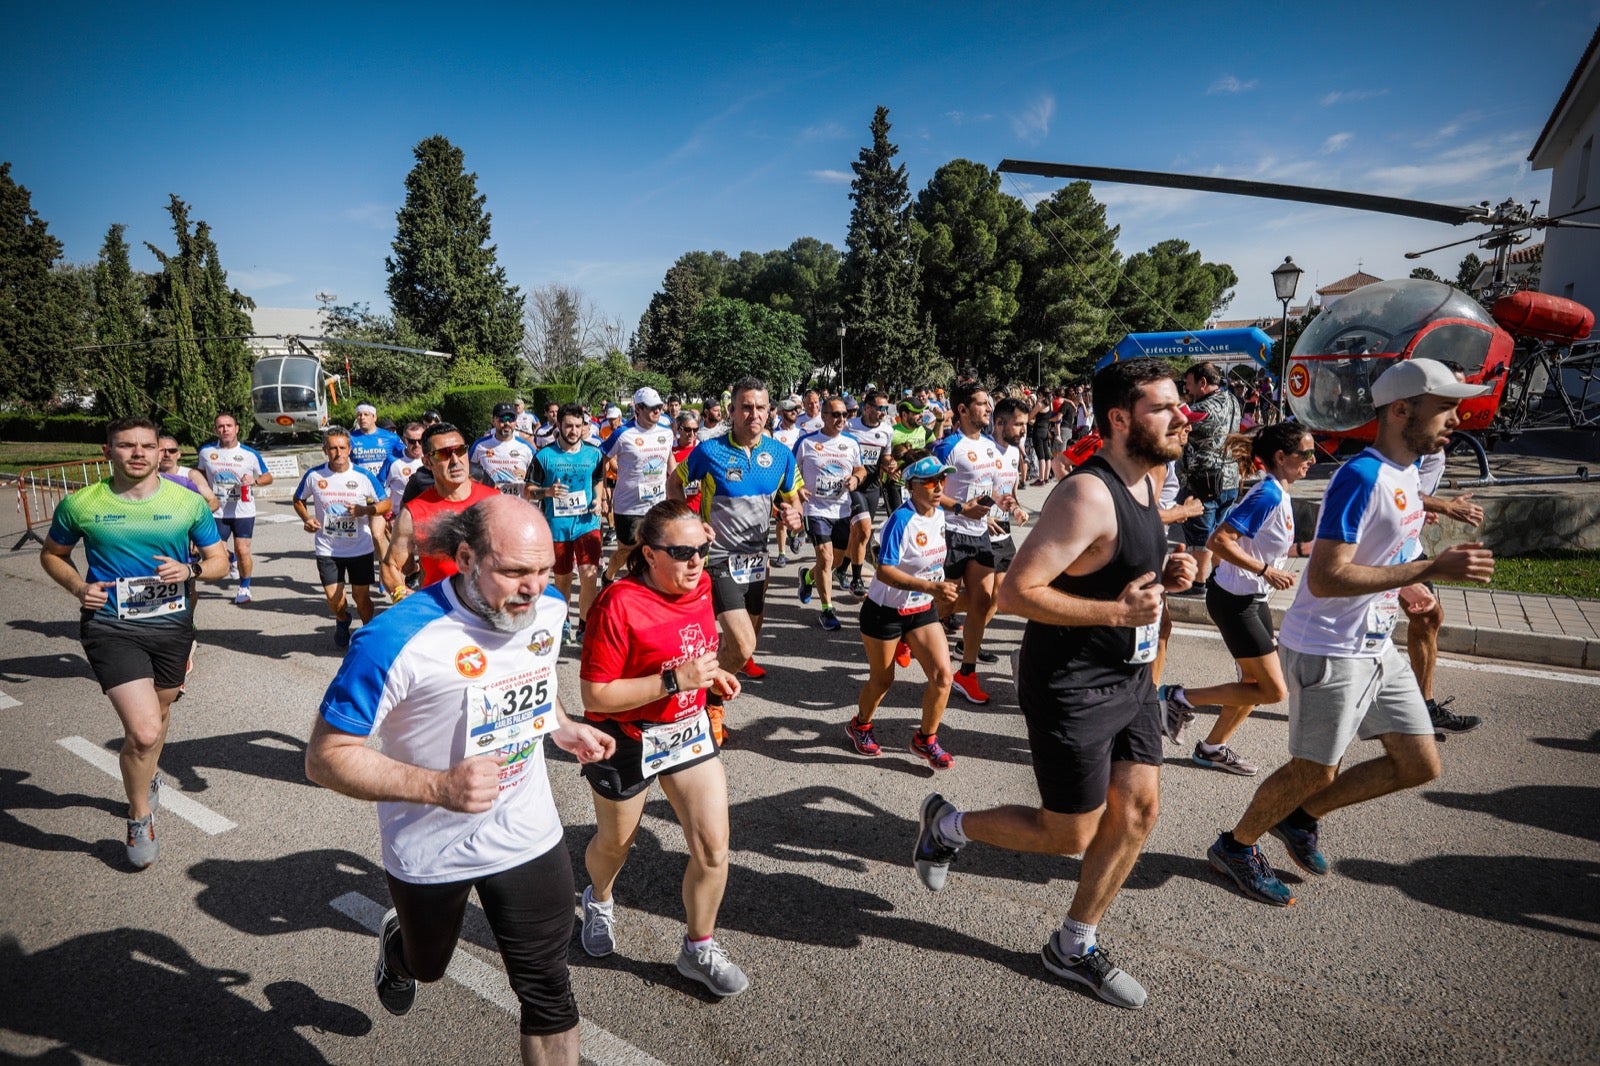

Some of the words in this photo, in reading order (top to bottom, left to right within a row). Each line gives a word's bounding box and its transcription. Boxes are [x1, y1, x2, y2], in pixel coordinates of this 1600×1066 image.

[1145, 346, 1183, 354] EJÉRCITO
[827, 481, 843, 489] 139
[569, 496, 580, 507] 31
[336, 521, 355, 530] 182
[743, 556, 764, 569] 122
[144, 583, 179, 600] 329
[490, 676, 518, 688] CARRERA
[518, 671, 533, 680] BASE
[502, 679, 548, 716] 325
[669, 720, 701, 749] 201
